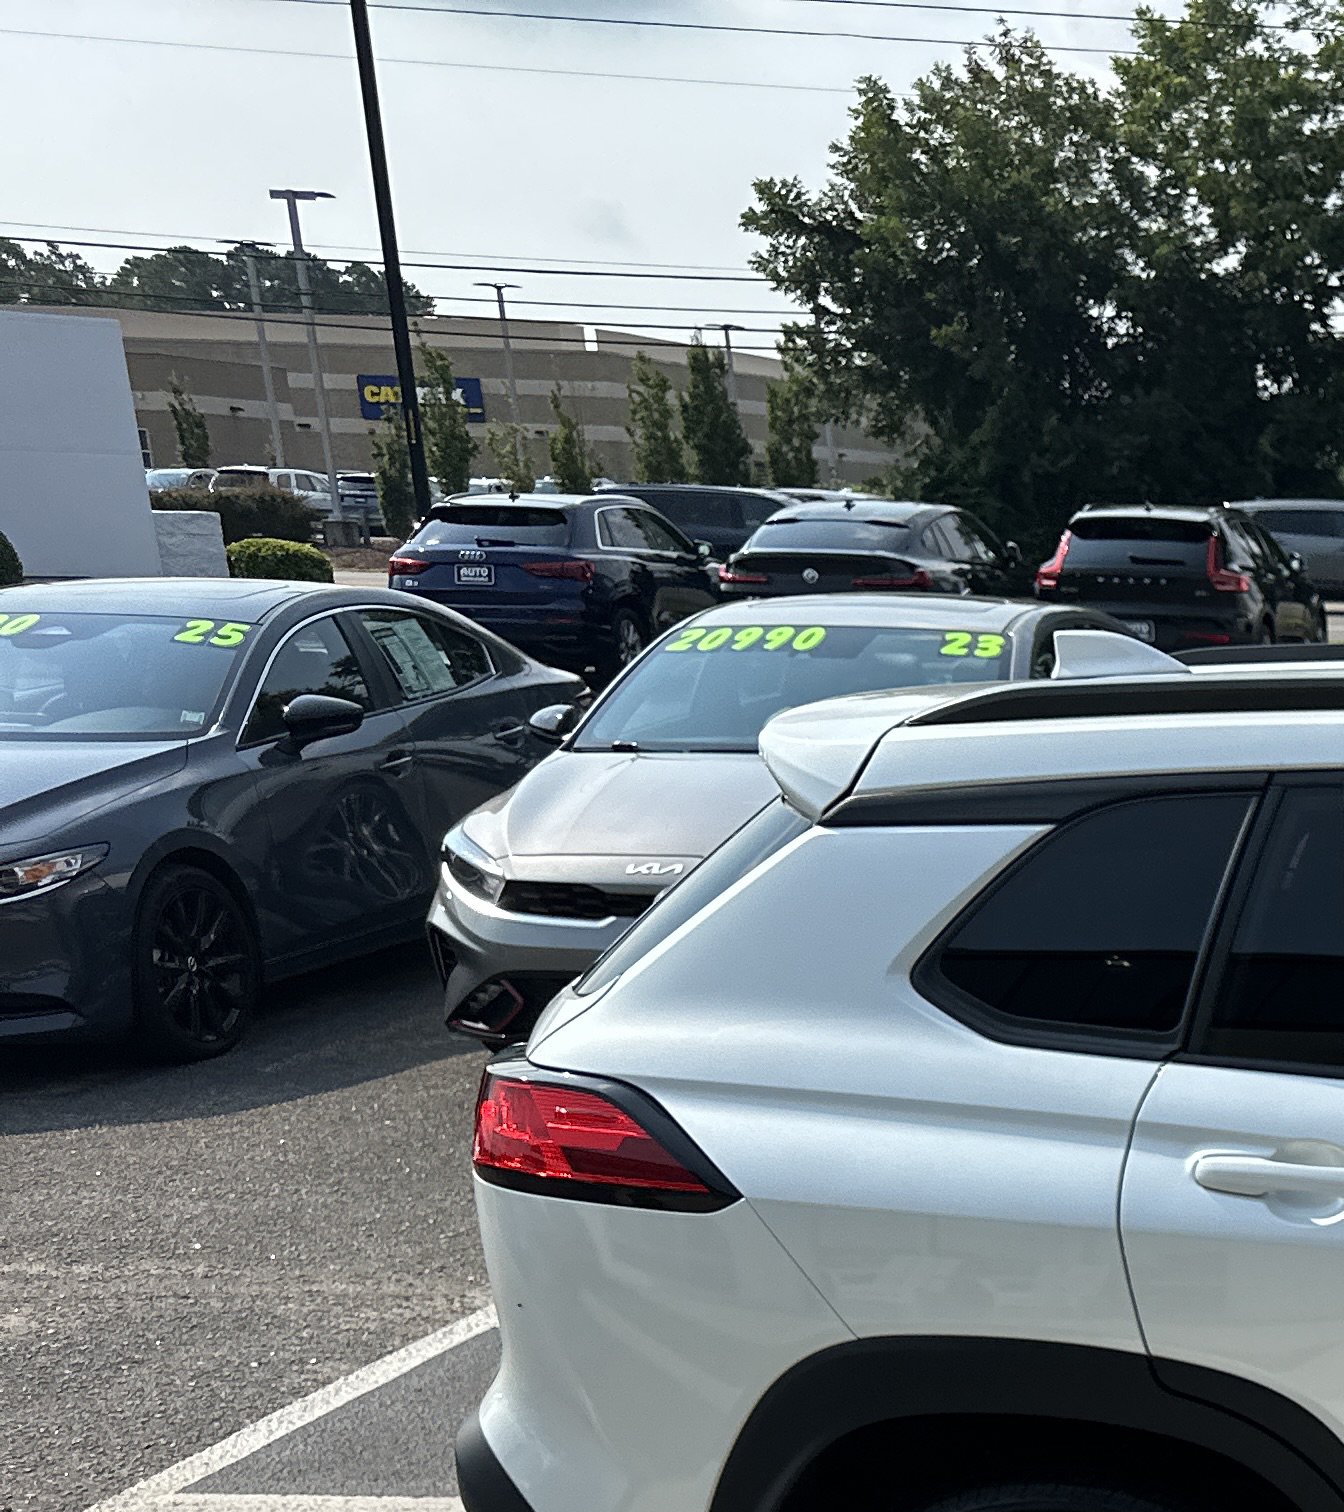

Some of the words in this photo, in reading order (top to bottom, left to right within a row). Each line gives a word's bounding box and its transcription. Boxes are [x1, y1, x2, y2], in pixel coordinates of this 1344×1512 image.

[174, 619, 251, 647] 25
[664, 626, 827, 652] 20990
[939, 632, 1006, 658] 23
